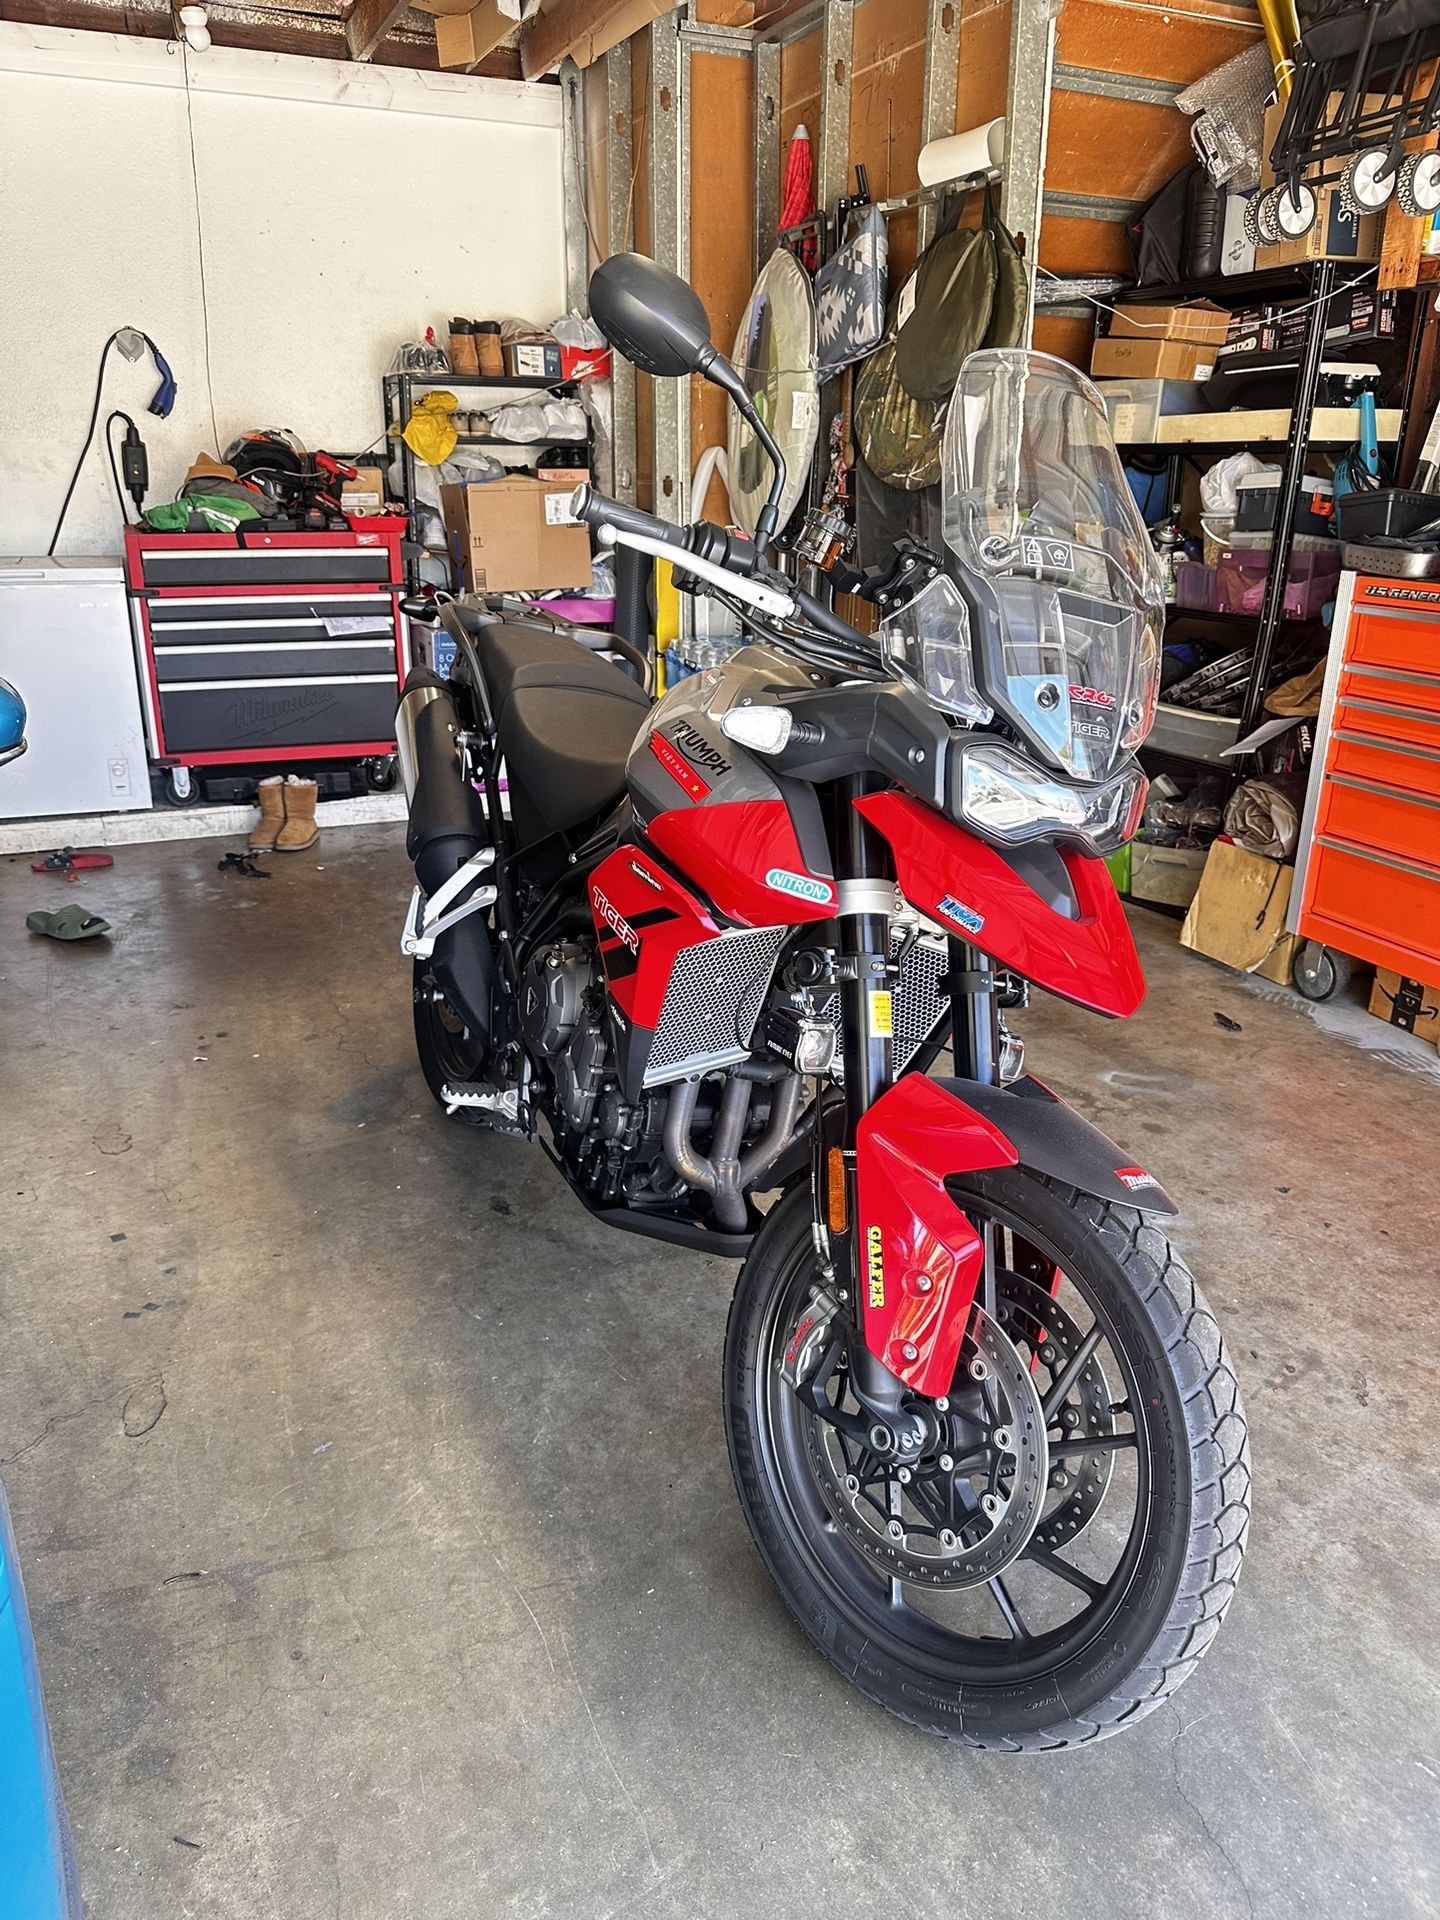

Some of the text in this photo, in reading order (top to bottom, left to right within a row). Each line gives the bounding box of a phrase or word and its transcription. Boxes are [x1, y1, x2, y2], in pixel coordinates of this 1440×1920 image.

[1389, 588, 1440, 602] GENER
[1068, 684, 1116, 705] CRG
[225, 688, 336, 729] Milwaukee
[1064, 720, 1110, 740] TIGER
[1300, 725, 1311, 752] SKIL
[669, 719, 732, 777] TRIUMPH
[674, 764, 689, 780] NAM
[772, 872, 824, 899] NITRON
[592, 885, 639, 956] TIGER
[766, 1040, 793, 1060] FUTURE EYES
[1120, 1173, 1158, 1188] Mak
[870, 1225, 885, 1309] GALFER
[785, 1316, 814, 1362] brembo
[736, 1326, 750, 1394] 100/90
[1156, 1388, 1178, 1526] ADVENTURE
